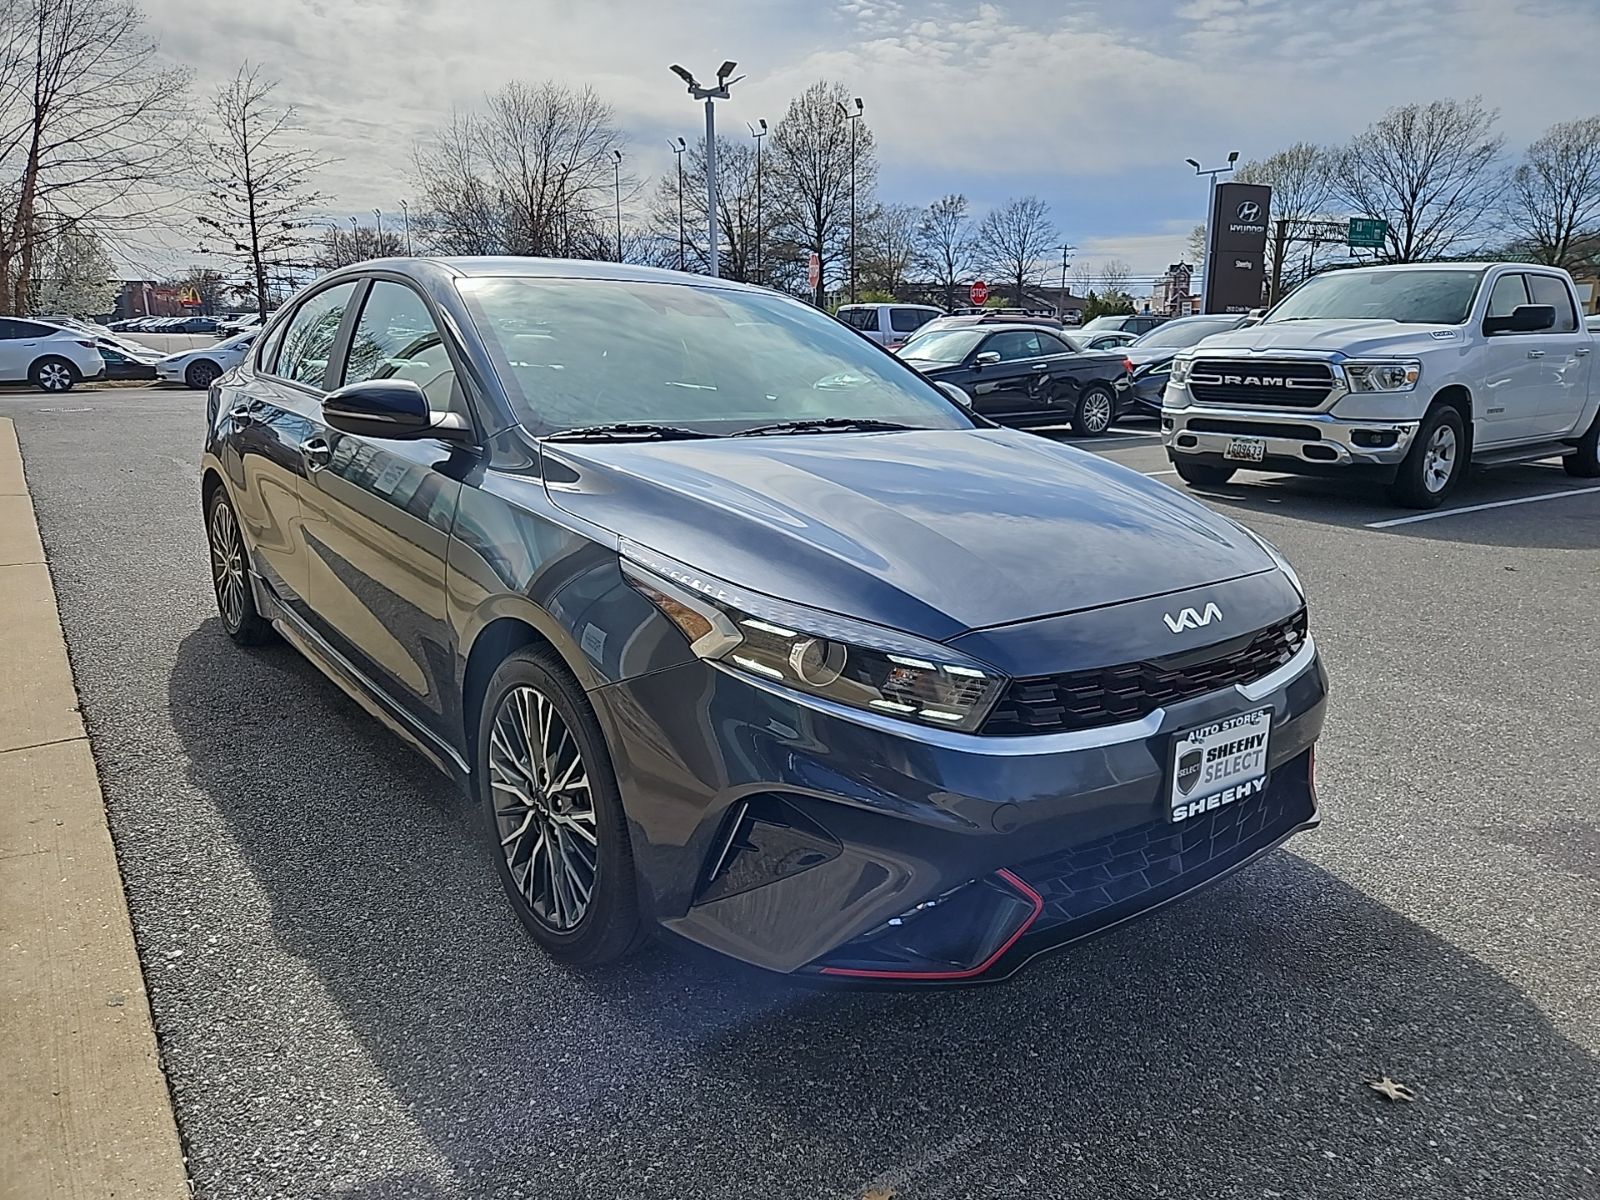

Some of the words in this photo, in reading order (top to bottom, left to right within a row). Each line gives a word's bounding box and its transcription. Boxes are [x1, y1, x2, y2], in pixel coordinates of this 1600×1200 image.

[1229, 224, 1266, 233] HYUNDAI
[971, 287, 987, 298] STOP
[1224, 375, 1283, 386] RAM
[1163, 602, 1223, 634] KIA
[1186, 723, 1220, 742] AUTO
[1221, 709, 1265, 731] STORES
[1205, 732, 1267, 763] SHEEHY
[1178, 763, 1200, 778] SELECT
[1204, 749, 1264, 784] SELECT
[1172, 775, 1268, 823] SHEEHY
